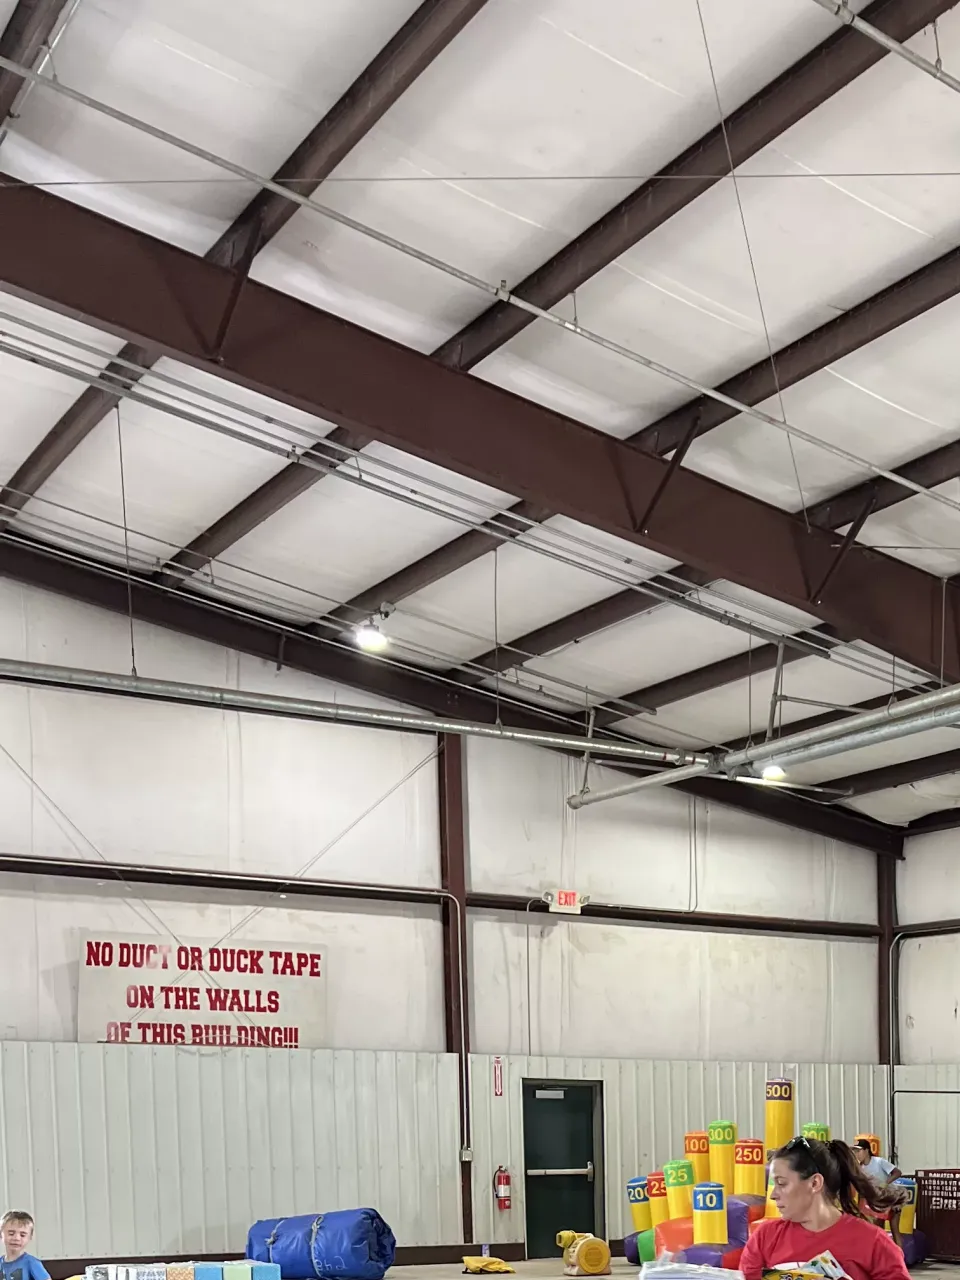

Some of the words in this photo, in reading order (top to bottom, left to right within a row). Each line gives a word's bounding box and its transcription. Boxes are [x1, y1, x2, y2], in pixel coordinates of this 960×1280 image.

[557, 890, 577, 907] EXIT
[86, 941, 114, 967] NO
[118, 942, 172, 969] DUCT
[177, 946, 204, 972] OR
[208, 947, 265, 975] DUCK
[269, 951, 322, 978] TAPE
[126, 985, 155, 1009] ON
[160, 986, 201, 1010] THE
[205, 987, 280, 1013] WALLS
[106, 1021, 132, 1043] OF
[138, 1022, 186, 1045] THIS
[190, 1024, 299, 1049] BUILDING!!!
[765, 1084, 790, 1098] 500
[708, 1127, 734, 1142] 300
[684, 1138, 708, 1151] 100
[735, 1147, 762, 1162] 250
[667, 1168, 688, 1183] 25
[696, 1192, 717, 1208] 10
